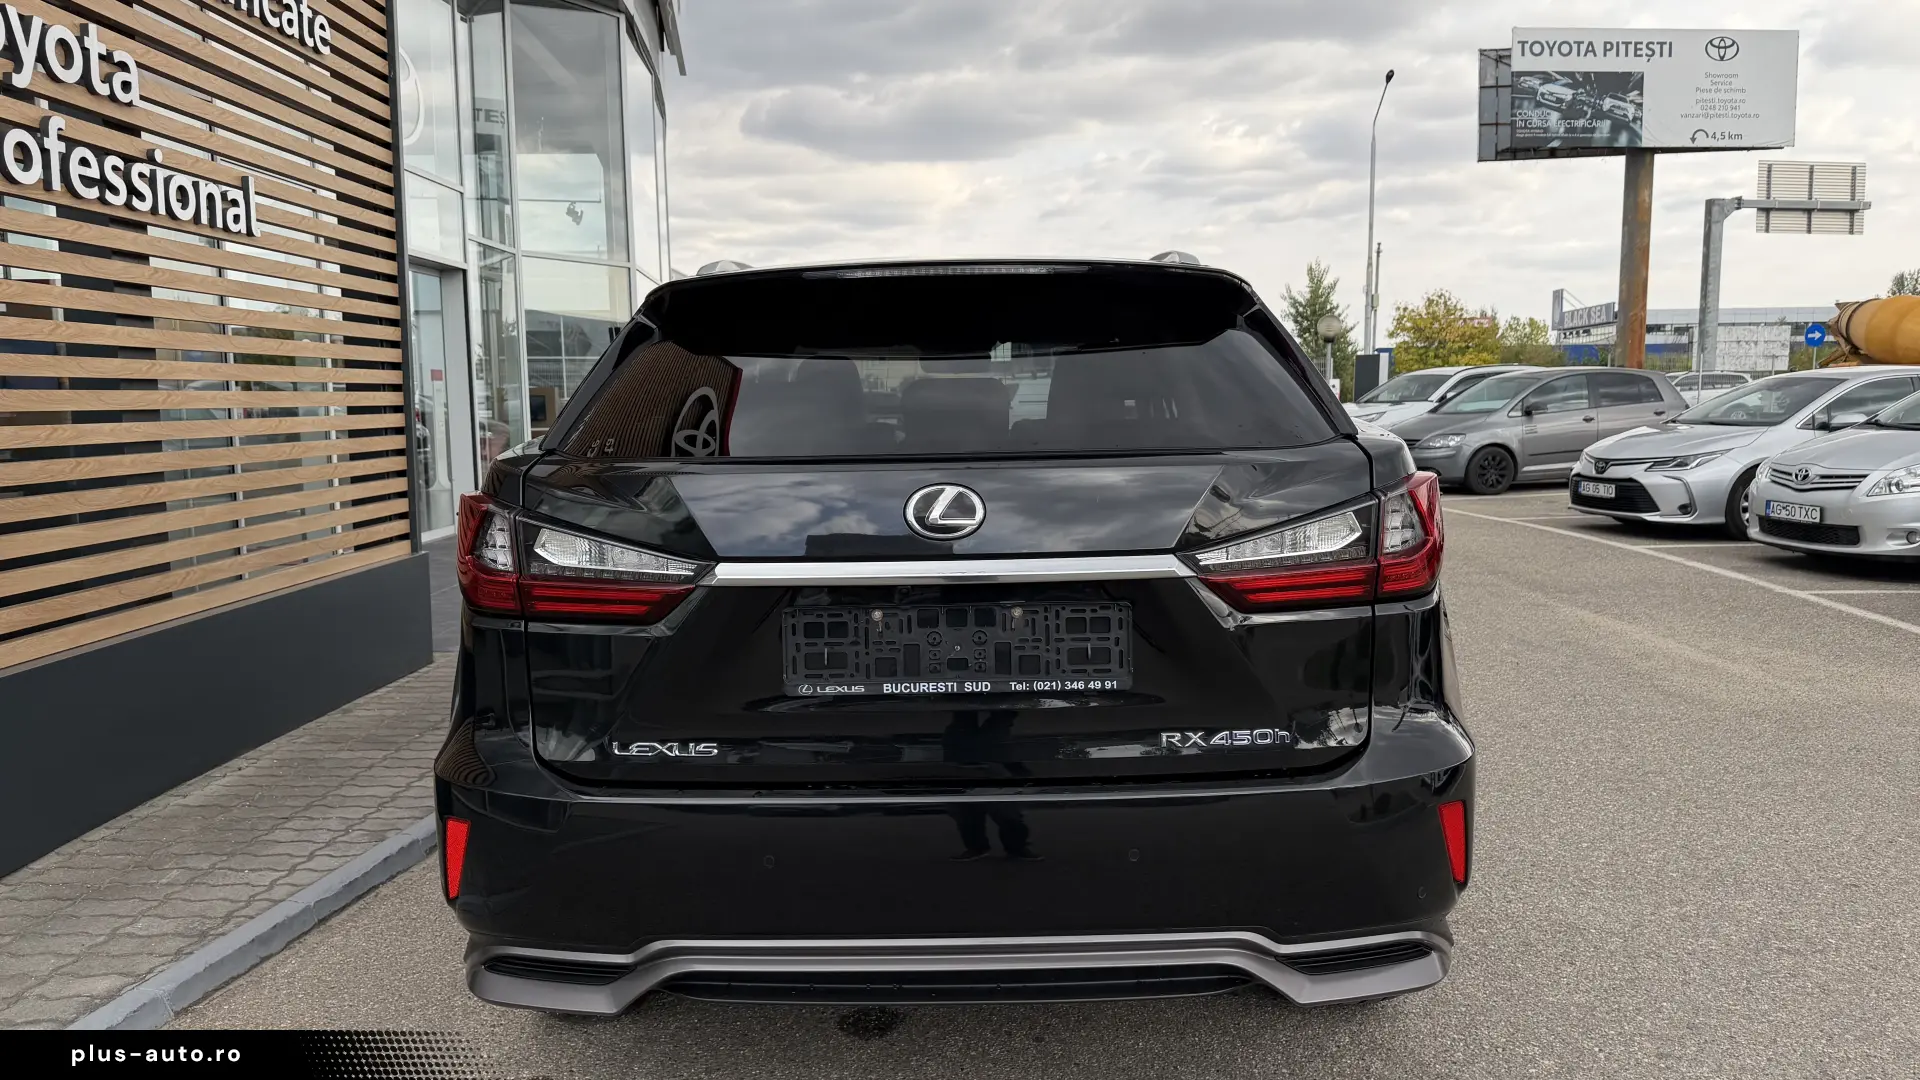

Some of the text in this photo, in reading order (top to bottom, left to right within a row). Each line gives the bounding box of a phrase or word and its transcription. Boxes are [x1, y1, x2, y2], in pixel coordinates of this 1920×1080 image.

[0, 3, 140, 106] yota
[1517, 40, 1673, 63] TOYOTA PITEȘTI
[1704, 71, 1739, 79] Showroom
[1695, 86, 1747, 94] Piese de schimb
[1711, 131, 1743, 142] 4,5 km
[3, 115, 261, 237] ofessional
[1564, 305, 1607, 328] BLACK SEA
[1771, 502, 1818, 520] AG 50 TXC
[816, 680, 1118, 694] LEXUS BUCURESTI SUD Tel: (021) 346 49 91
[612, 741, 718, 757] LEXUS
